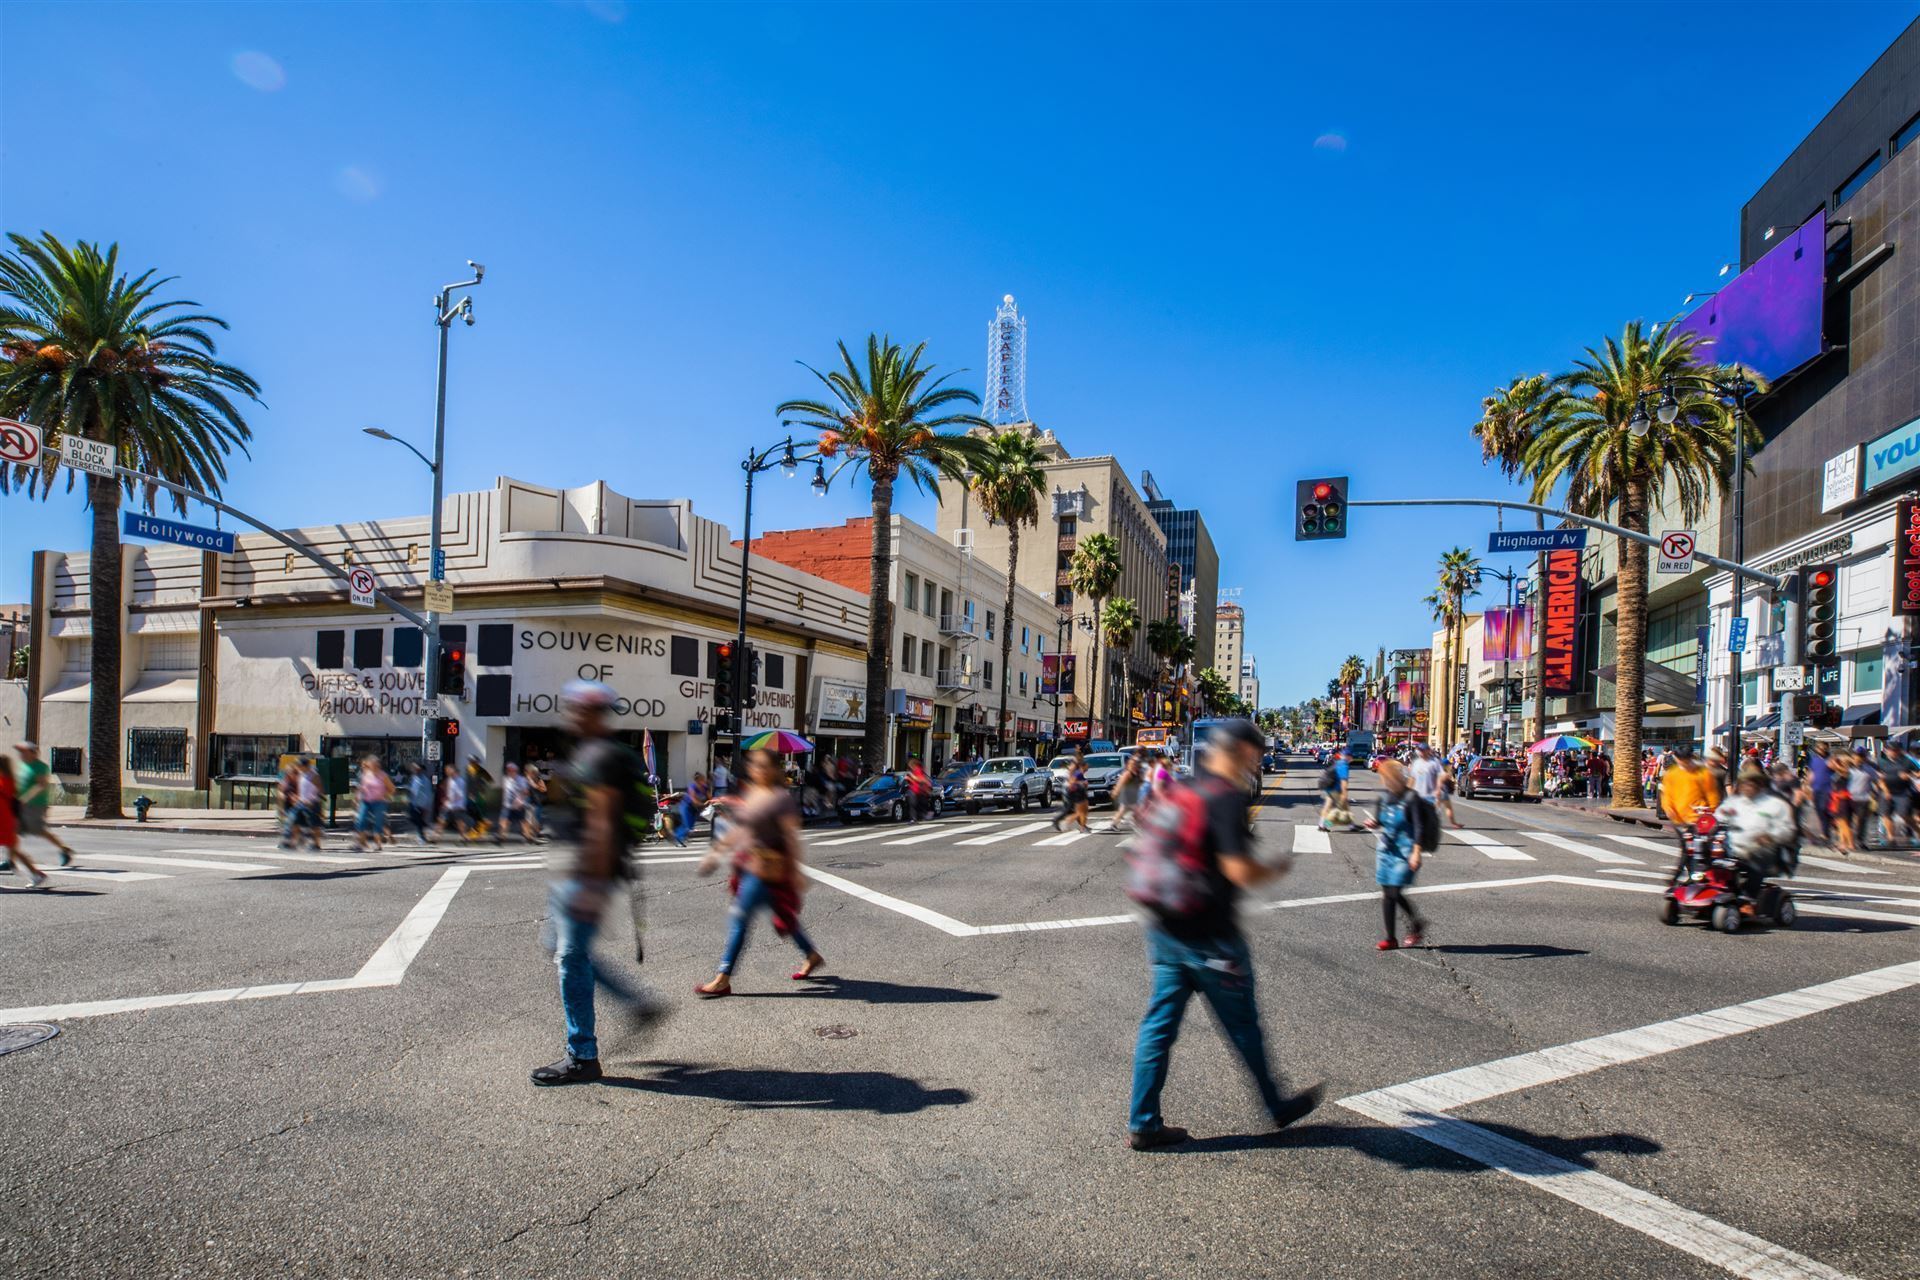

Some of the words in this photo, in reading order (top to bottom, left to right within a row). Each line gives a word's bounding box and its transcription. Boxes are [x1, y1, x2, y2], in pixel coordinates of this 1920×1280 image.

[69, 438, 84, 449] DO
[89, 443, 108, 456] NOT
[63, 458, 112, 475] INTERSECTION
[71, 450, 105, 465] BLOCK
[138, 520, 223, 547] Hollywood
[1497, 535, 1554, 549] Highland
[1560, 534, 1577, 544] Av
[1660, 562, 1672, 570] ON
[1673, 562, 1690, 570] RED
[1902, 571, 1920, 609] Foot
[362, 596, 374, 605] RED
[520, 630, 666, 657] SOUVENIRS
[1736, 619, 1746, 651] SYNC
[362, 676, 374, 688] &
[380, 672, 425, 691] SOUVE
[577, 663, 614, 682] OF
[1459, 667, 1467, 694] THEATRE
[1822, 670, 1839, 683] LIFE
[1775, 679, 1786, 688] OK
[334, 697, 375, 715] HOUR
[381, 692, 423, 715] PHOT
[517, 693, 666, 717] HOLOOD
[1458, 695, 1466, 716] DOLBY
[745, 711, 781, 728] PHOTO
